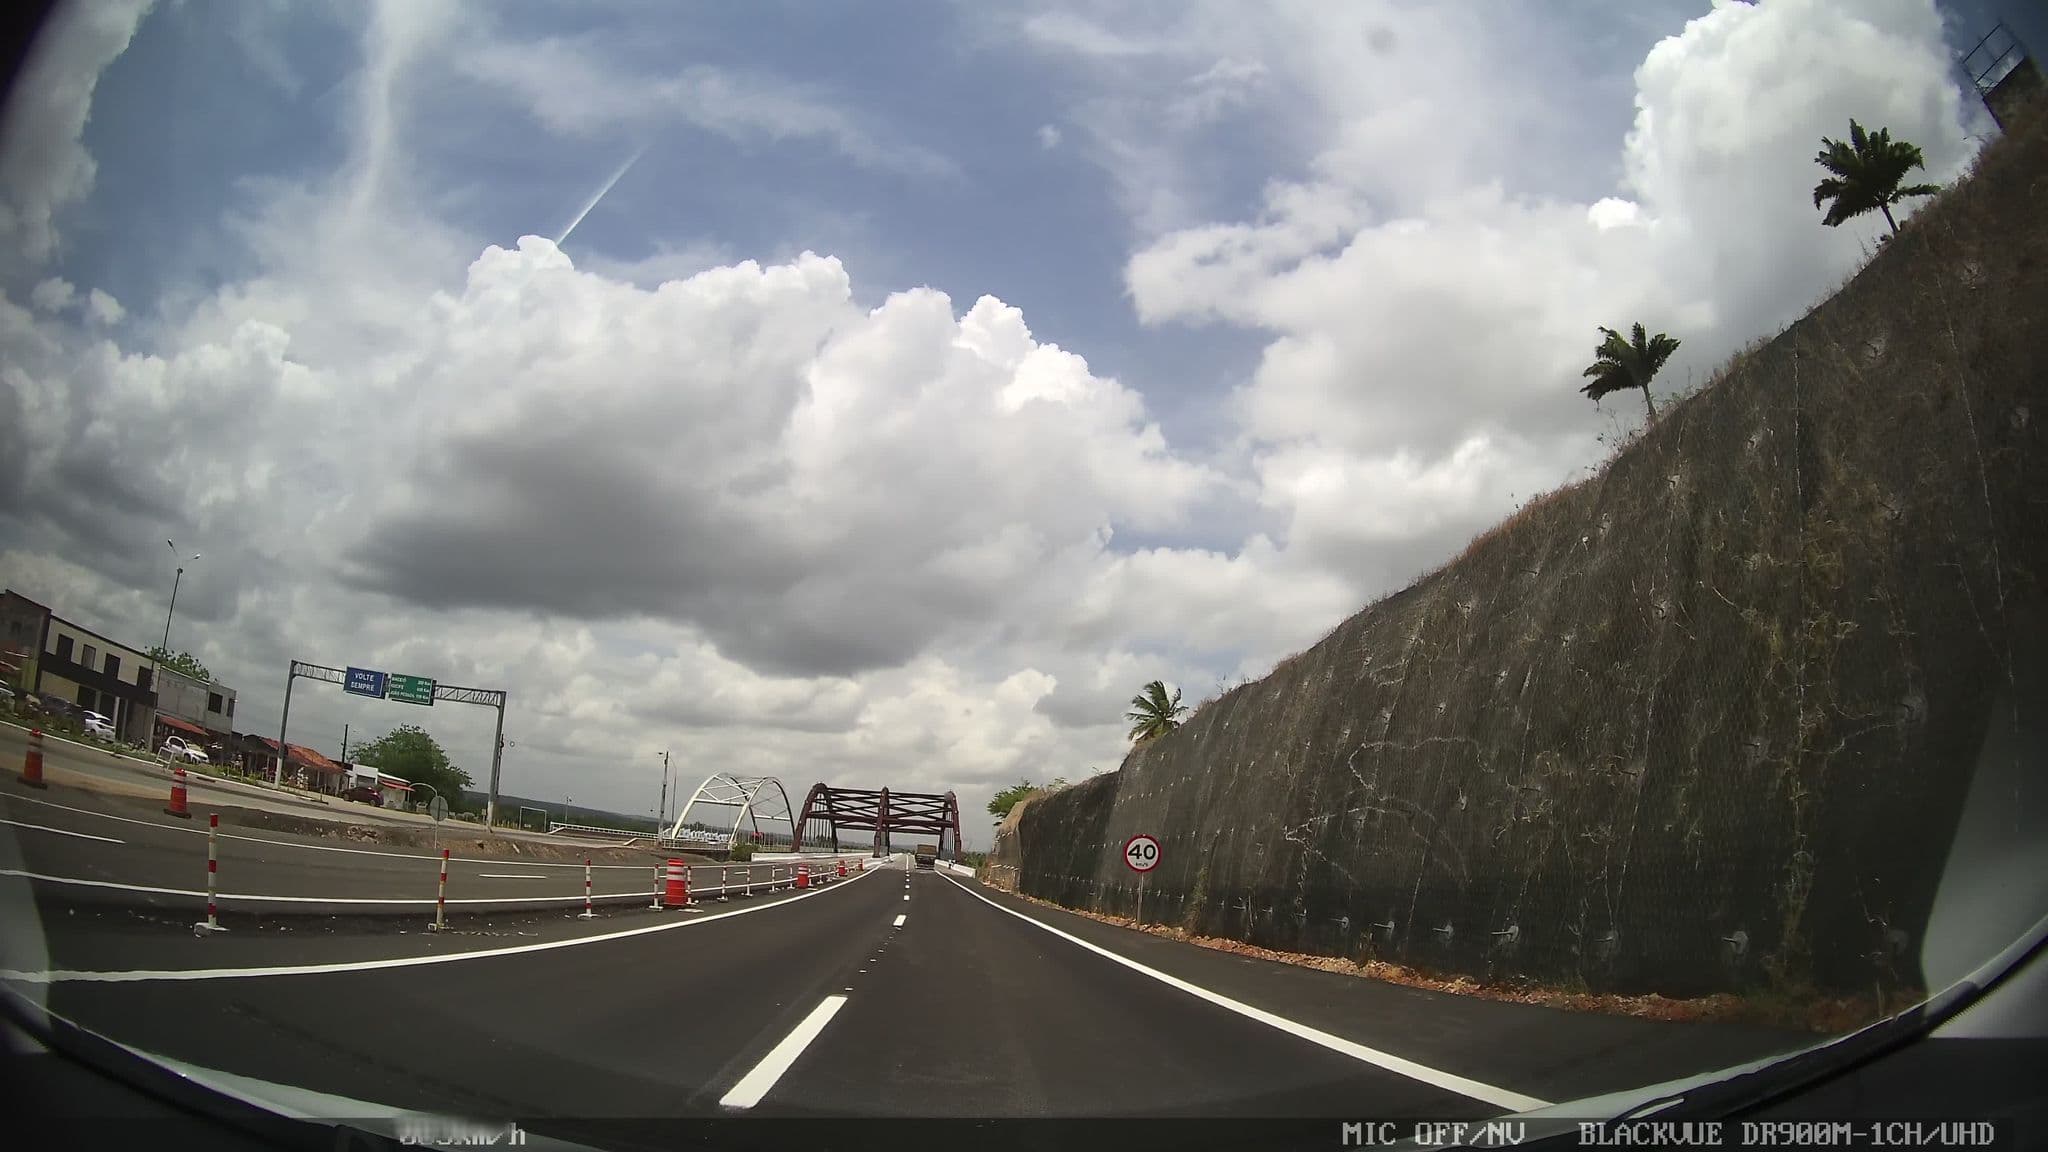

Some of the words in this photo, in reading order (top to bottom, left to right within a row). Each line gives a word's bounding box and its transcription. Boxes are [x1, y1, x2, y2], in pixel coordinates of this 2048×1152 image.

[354, 672, 374, 682] VOLTE
[350, 681, 375, 692] SEMPRE
[1127, 844, 1156, 860] 40
